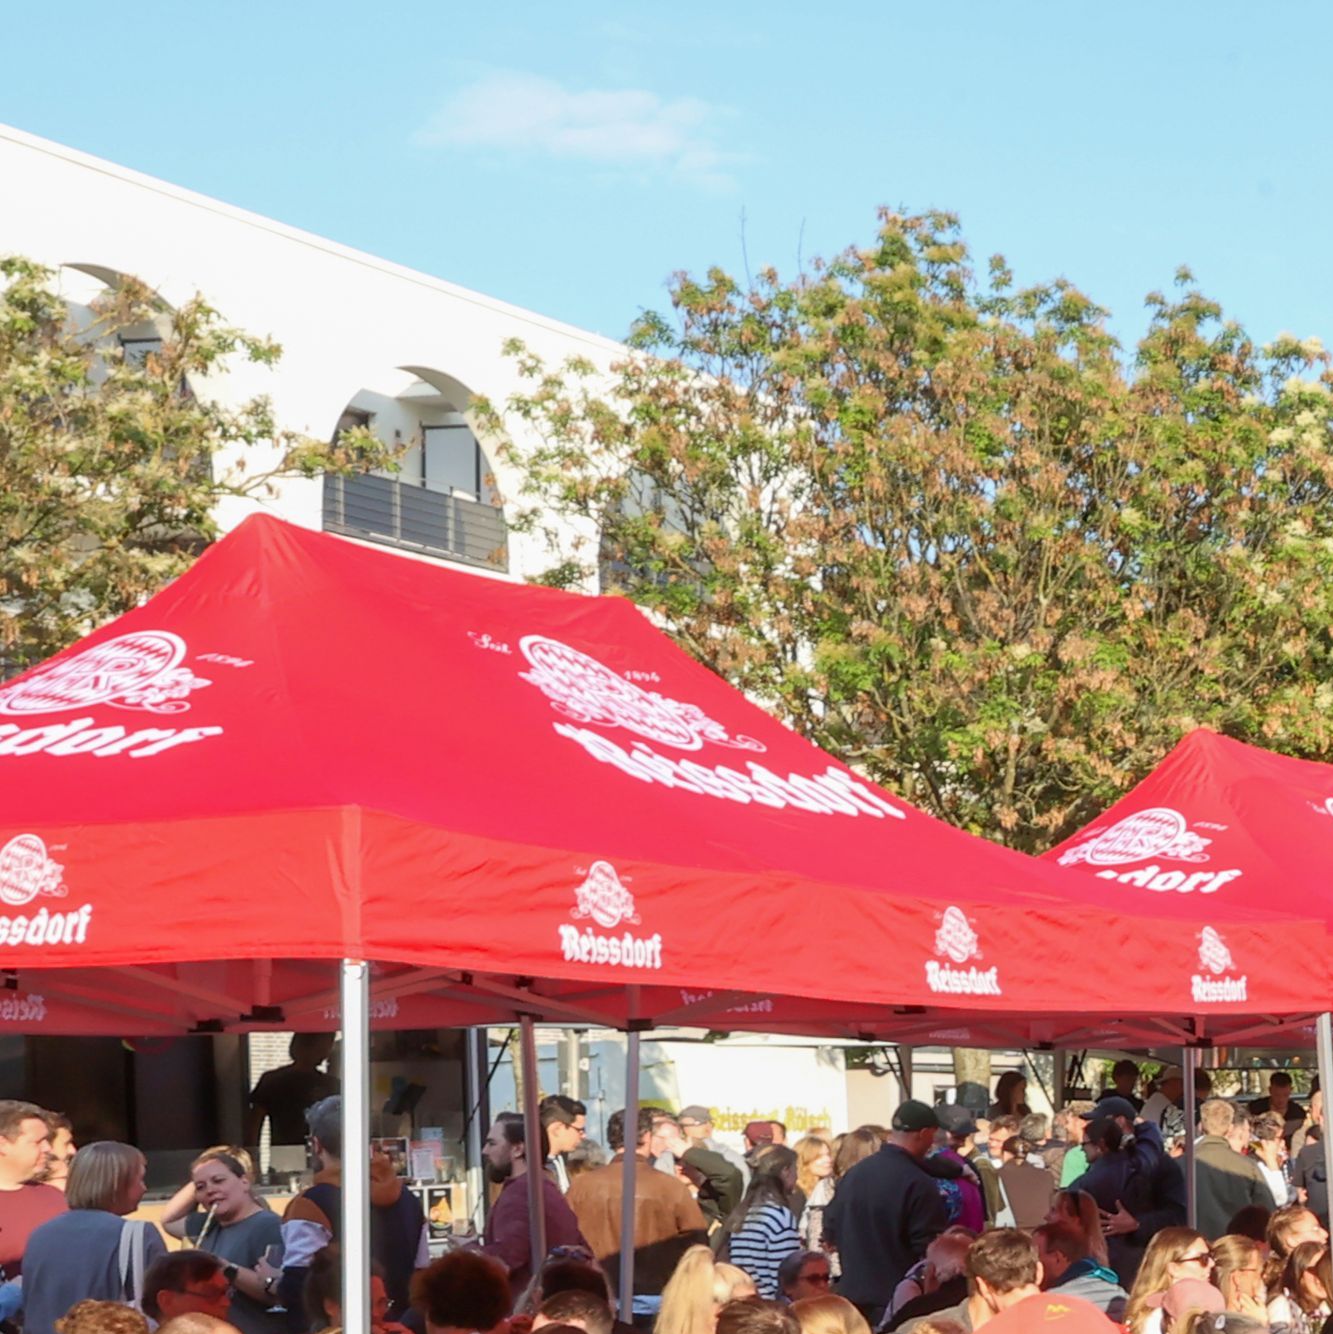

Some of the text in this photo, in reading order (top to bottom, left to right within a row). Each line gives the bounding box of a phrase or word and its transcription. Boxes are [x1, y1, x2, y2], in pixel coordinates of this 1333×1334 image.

[552, 721, 907, 819] Reissdorf
[558, 924, 662, 969] Reissdorf
[924, 960, 1002, 995] Reissdorf
[1191, 975, 1248, 1002] Reissdorf
